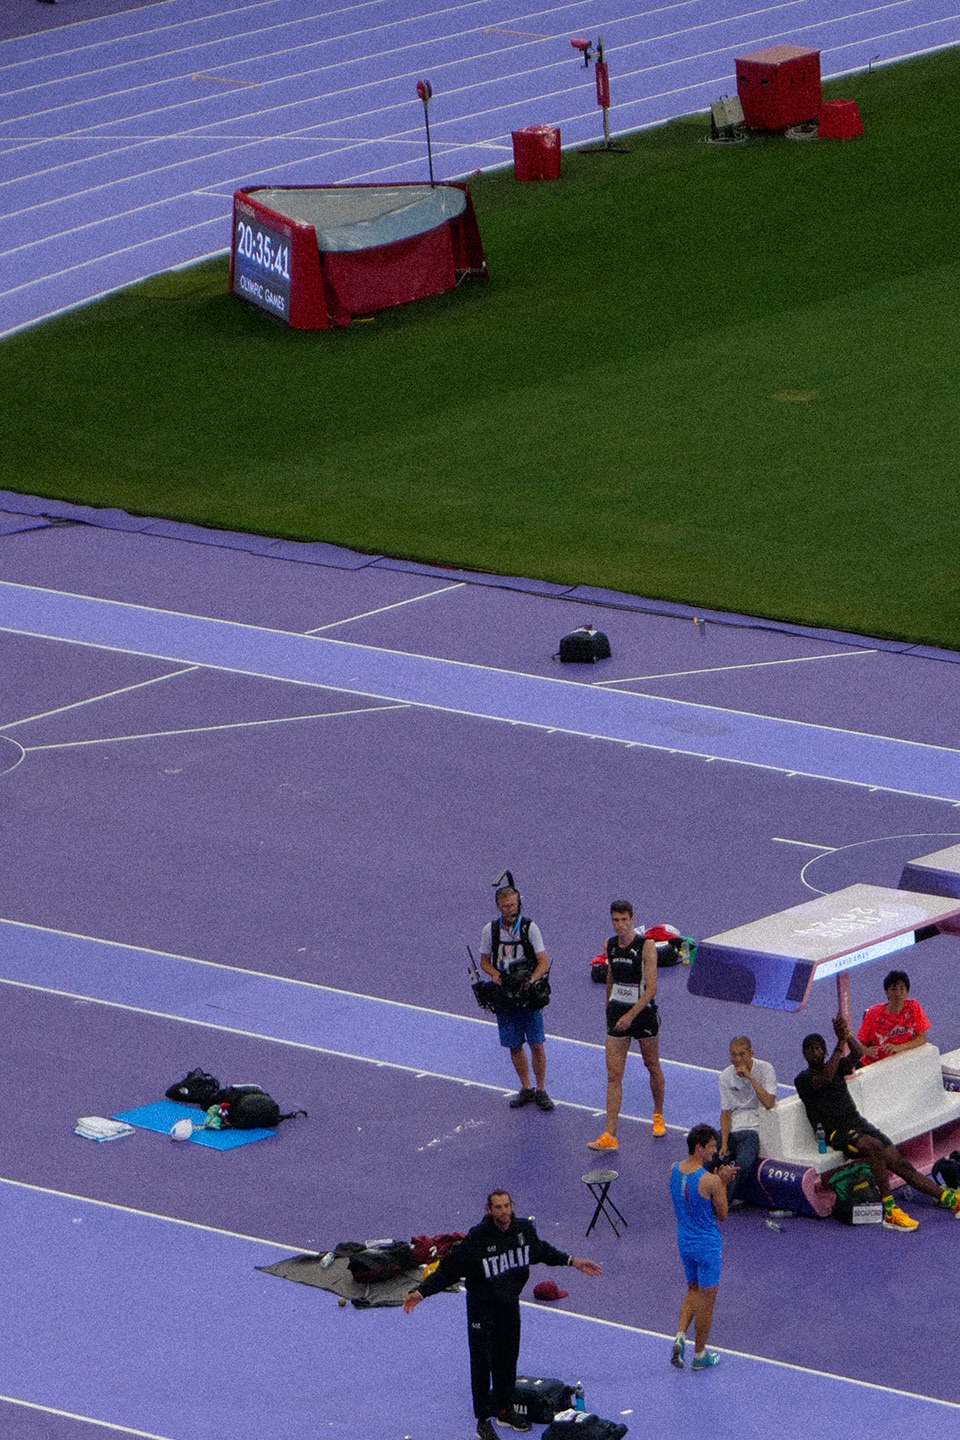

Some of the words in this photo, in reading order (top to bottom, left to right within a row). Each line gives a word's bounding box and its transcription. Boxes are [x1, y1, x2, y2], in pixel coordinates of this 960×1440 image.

[238, 221, 290, 280] 20:35:41
[264, 288, 285, 311] GAMES
[768, 1168, 796, 1182] 2024
